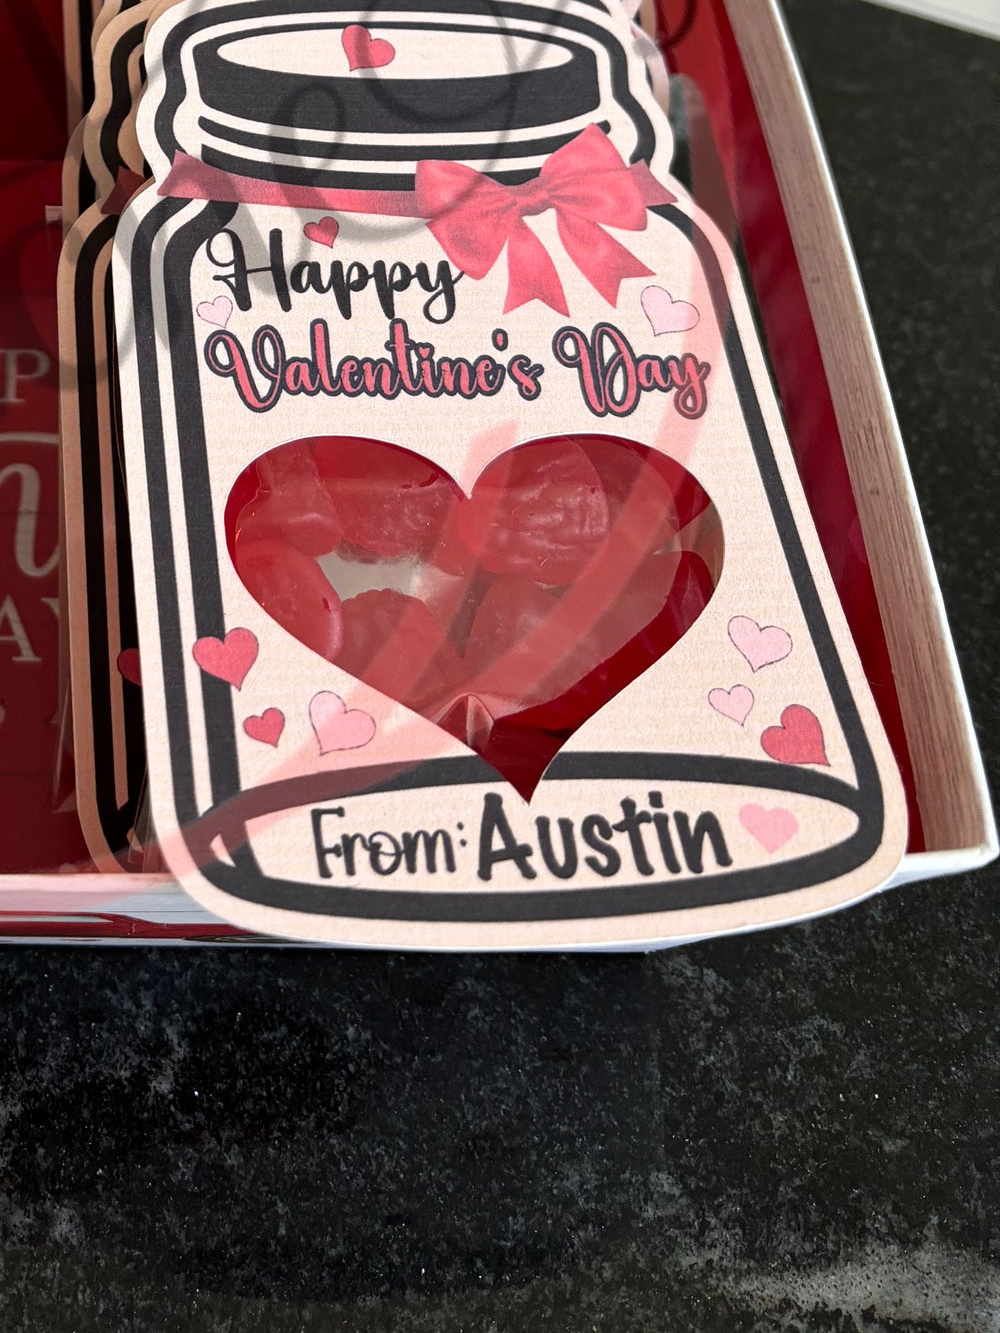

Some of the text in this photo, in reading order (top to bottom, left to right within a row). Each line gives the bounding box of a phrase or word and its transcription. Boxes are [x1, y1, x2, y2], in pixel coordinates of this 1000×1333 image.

[206, 228, 465, 324] Happy
[203, 318, 711, 419] Valentine's Day
